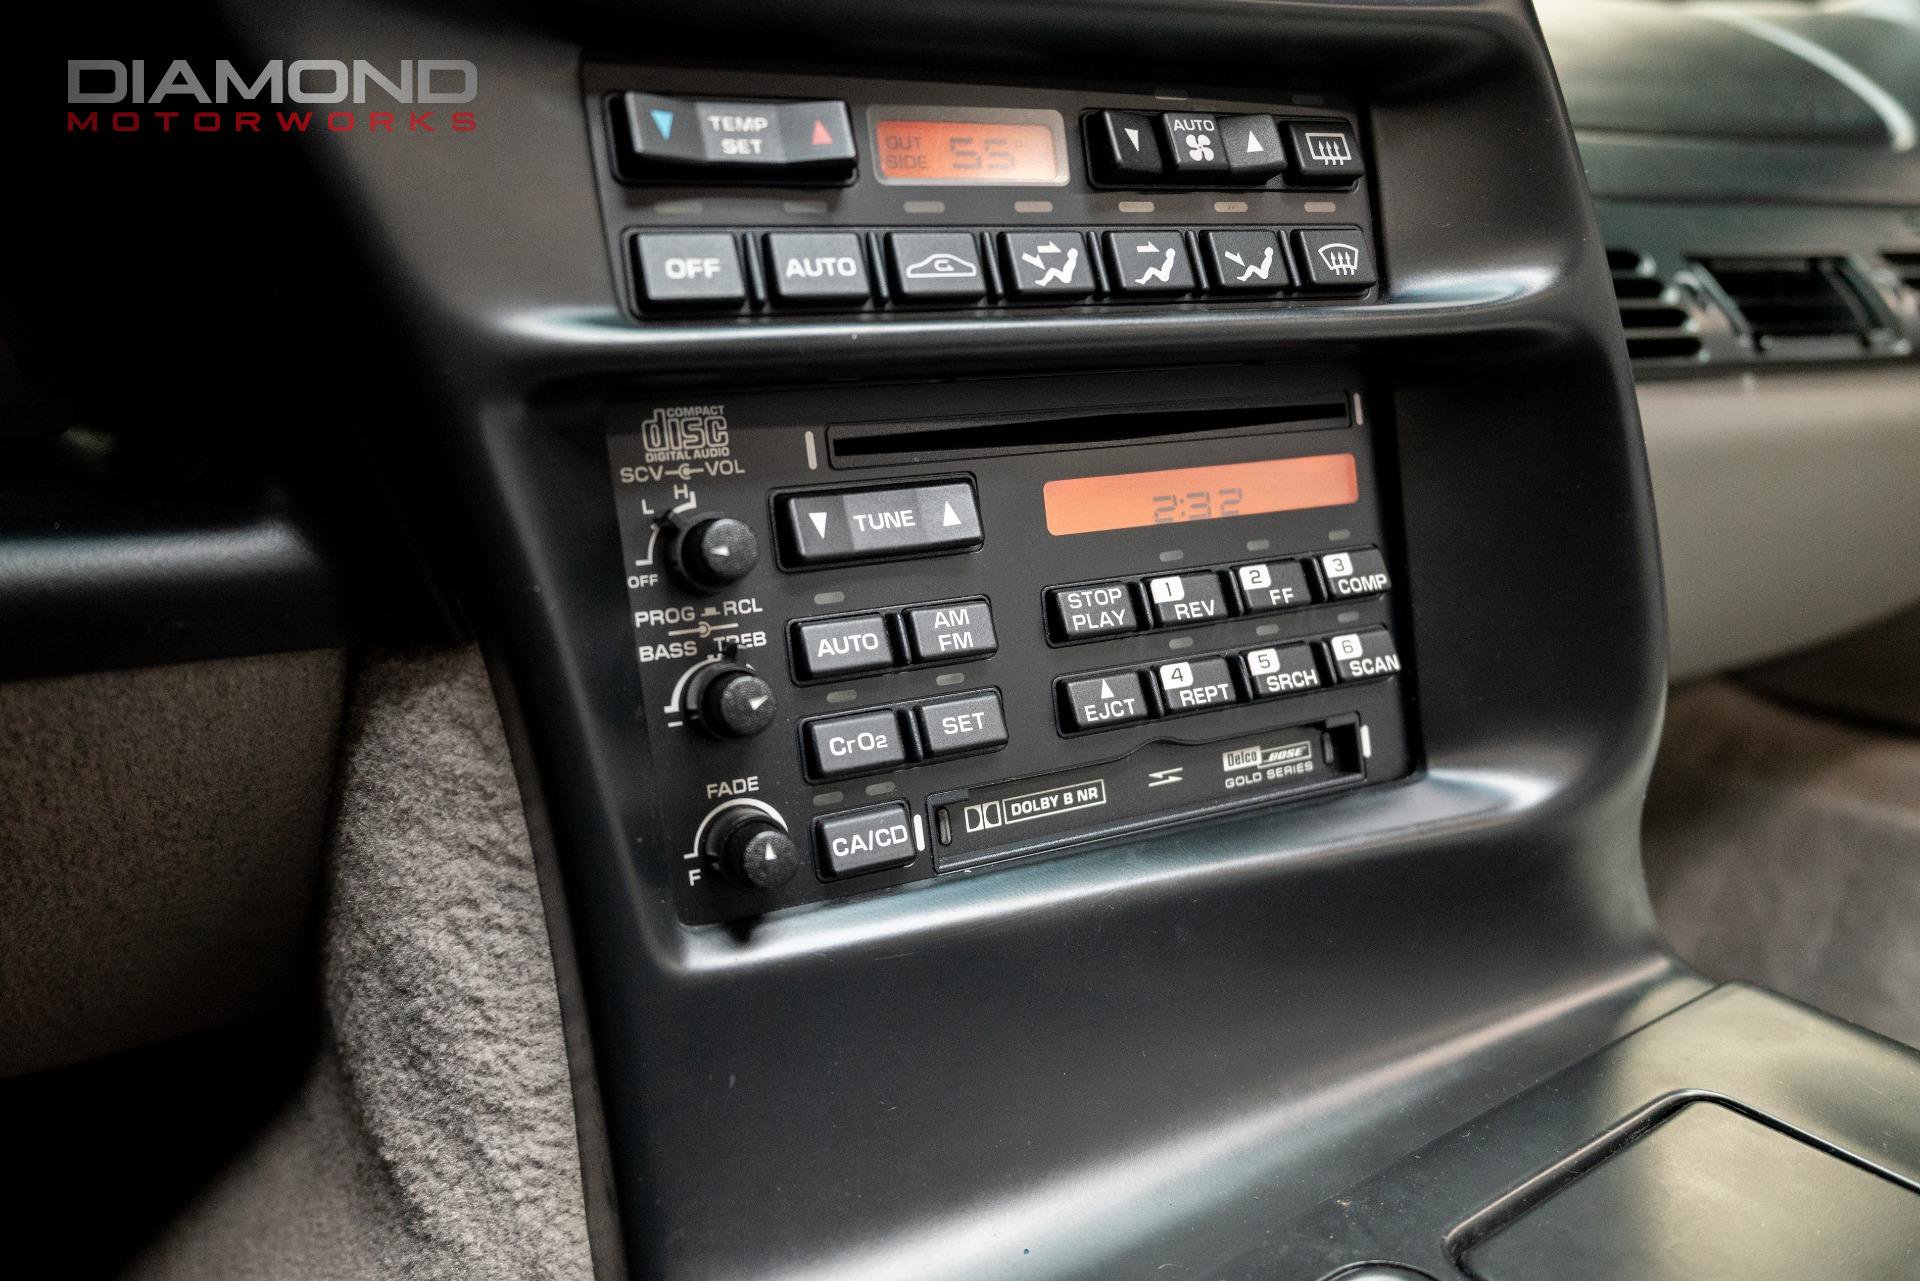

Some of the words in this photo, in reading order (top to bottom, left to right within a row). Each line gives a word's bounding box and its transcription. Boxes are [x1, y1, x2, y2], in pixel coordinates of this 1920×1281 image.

[707, 115, 768, 133] TEMP
[1173, 118, 1215, 133] AUTO
[720, 138, 763, 155] SET
[885, 136, 922, 151] OUT
[885, 154, 929, 170] SIDE
[665, 257, 721, 280] OFF
[786, 256, 857, 278] AUTO
[666, 405, 725, 418] COMPACT
[641, 408, 729, 452] disc
[645, 449, 691, 463] DIGITAL
[693, 446, 730, 460] AUDIO
[620, 465, 664, 483] SCV
[704, 459, 746, 476] VOL
[673, 484, 689, 500] H
[641, 499, 654, 515] L
[1152, 487, 1243, 525] 2:32
[853, 510, 916, 532] TUNE
[1332, 557, 1346, 573] 3
[627, 573, 659, 589] OFF
[1250, 569, 1263, 585] 2
[1337, 573, 1388, 594] COMP
[1067, 588, 1123, 609] STOP
[1164, 581, 1174, 598] 1
[1269, 588, 1295, 606] FF
[635, 606, 696, 628] PROG
[723, 598, 763, 616] RCL
[934, 608, 970, 629] AM
[1072, 610, 1127, 631] PLAY
[1175, 600, 1216, 620] REV
[638, 641, 698, 663] BASS
[817, 633, 879, 658] AUTO
[938, 631, 974, 652] FM
[1341, 639, 1354, 655] 6
[1257, 653, 1271, 669] 5
[1350, 654, 1400, 677] SCAN
[1171, 666, 1184, 683] 4
[1266, 669, 1318, 692] SRCH
[1179, 683, 1229, 707] REPT
[1084, 698, 1136, 722] EJCT
[942, 711, 985, 735] SET
[1226, 750, 1258, 767] Delco
[1225, 772, 1262, 789] GOLD
[1266, 761, 1313, 780] SERIES
[706, 776, 760, 799] FADE
[1011, 795, 1058, 816] DOLBY
[1063, 792, 1074, 806] B
[1077, 786, 1099, 803] NR
[832, 824, 908, 857] CA/CD
[688, 869, 702, 887] F
